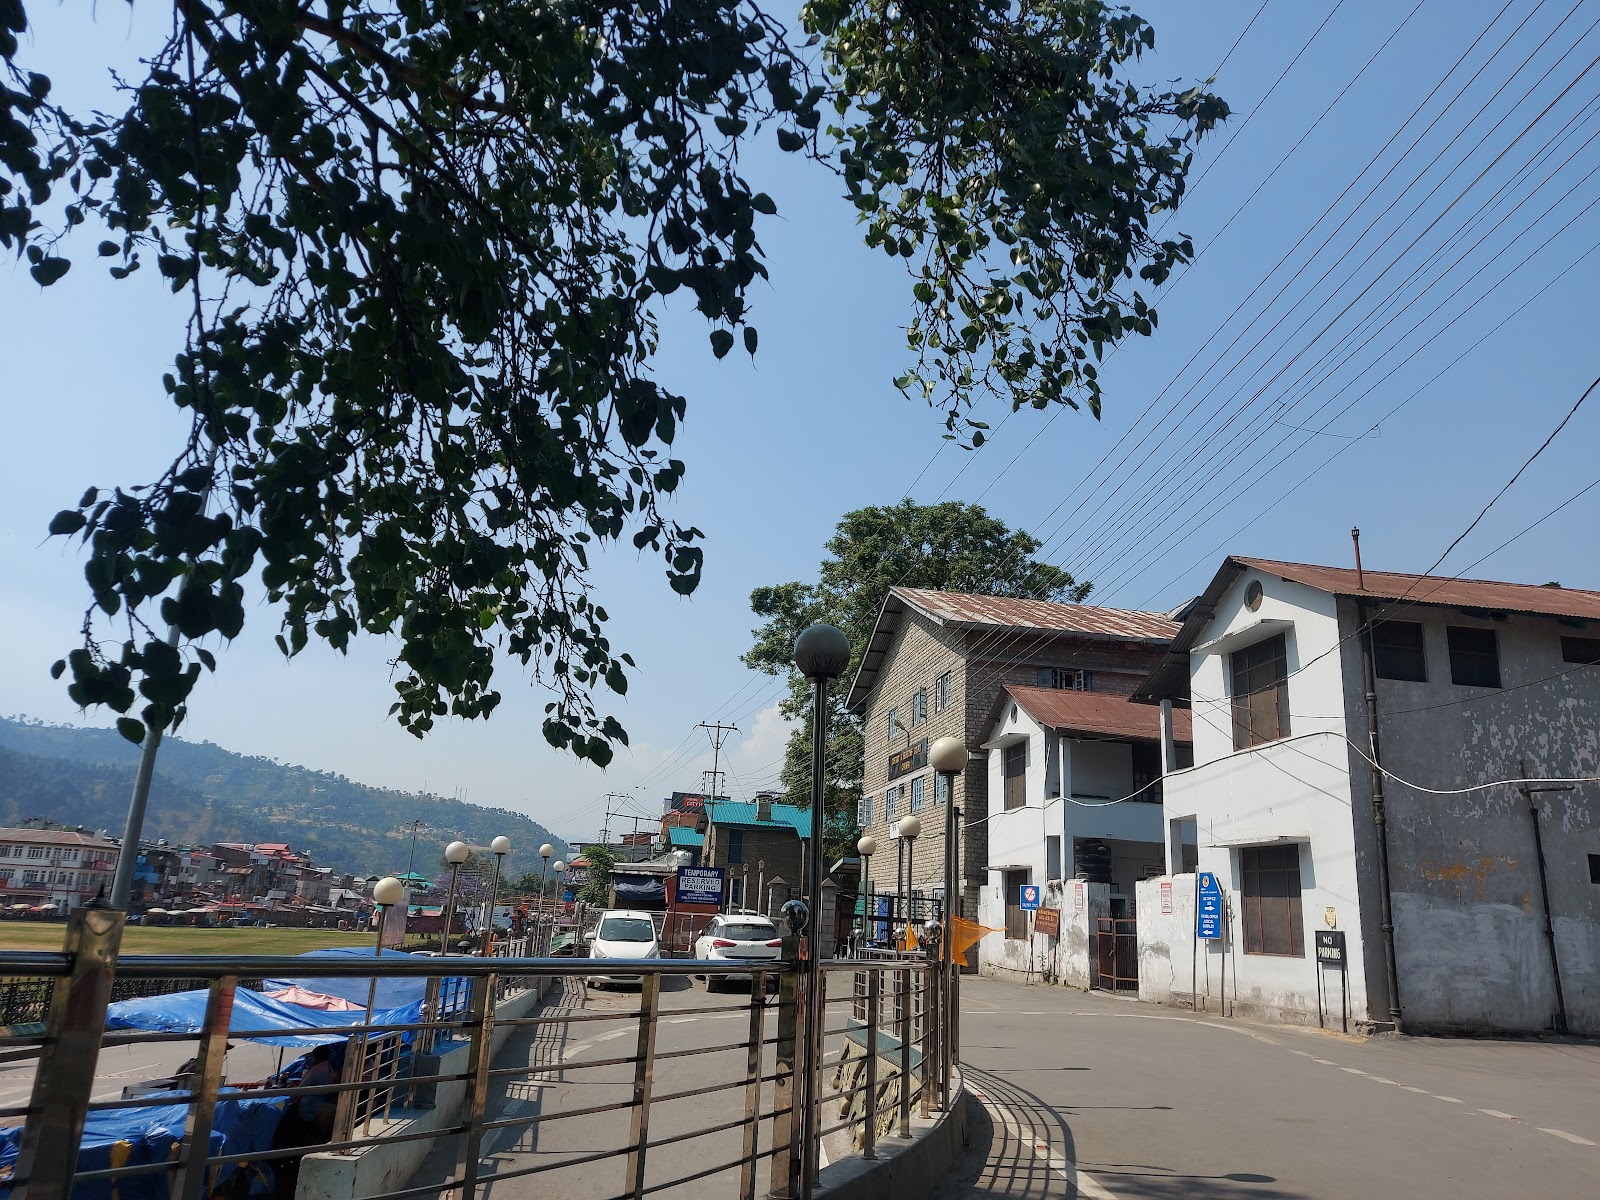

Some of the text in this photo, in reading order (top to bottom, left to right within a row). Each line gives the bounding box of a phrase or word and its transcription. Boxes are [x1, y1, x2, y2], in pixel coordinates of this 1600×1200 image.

[684, 869, 719, 878] TEMPORARY
[681, 877, 720, 885] RESERVED
[1322, 936, 1333, 945] NO
[1318, 947, 1341, 960] PARKING
